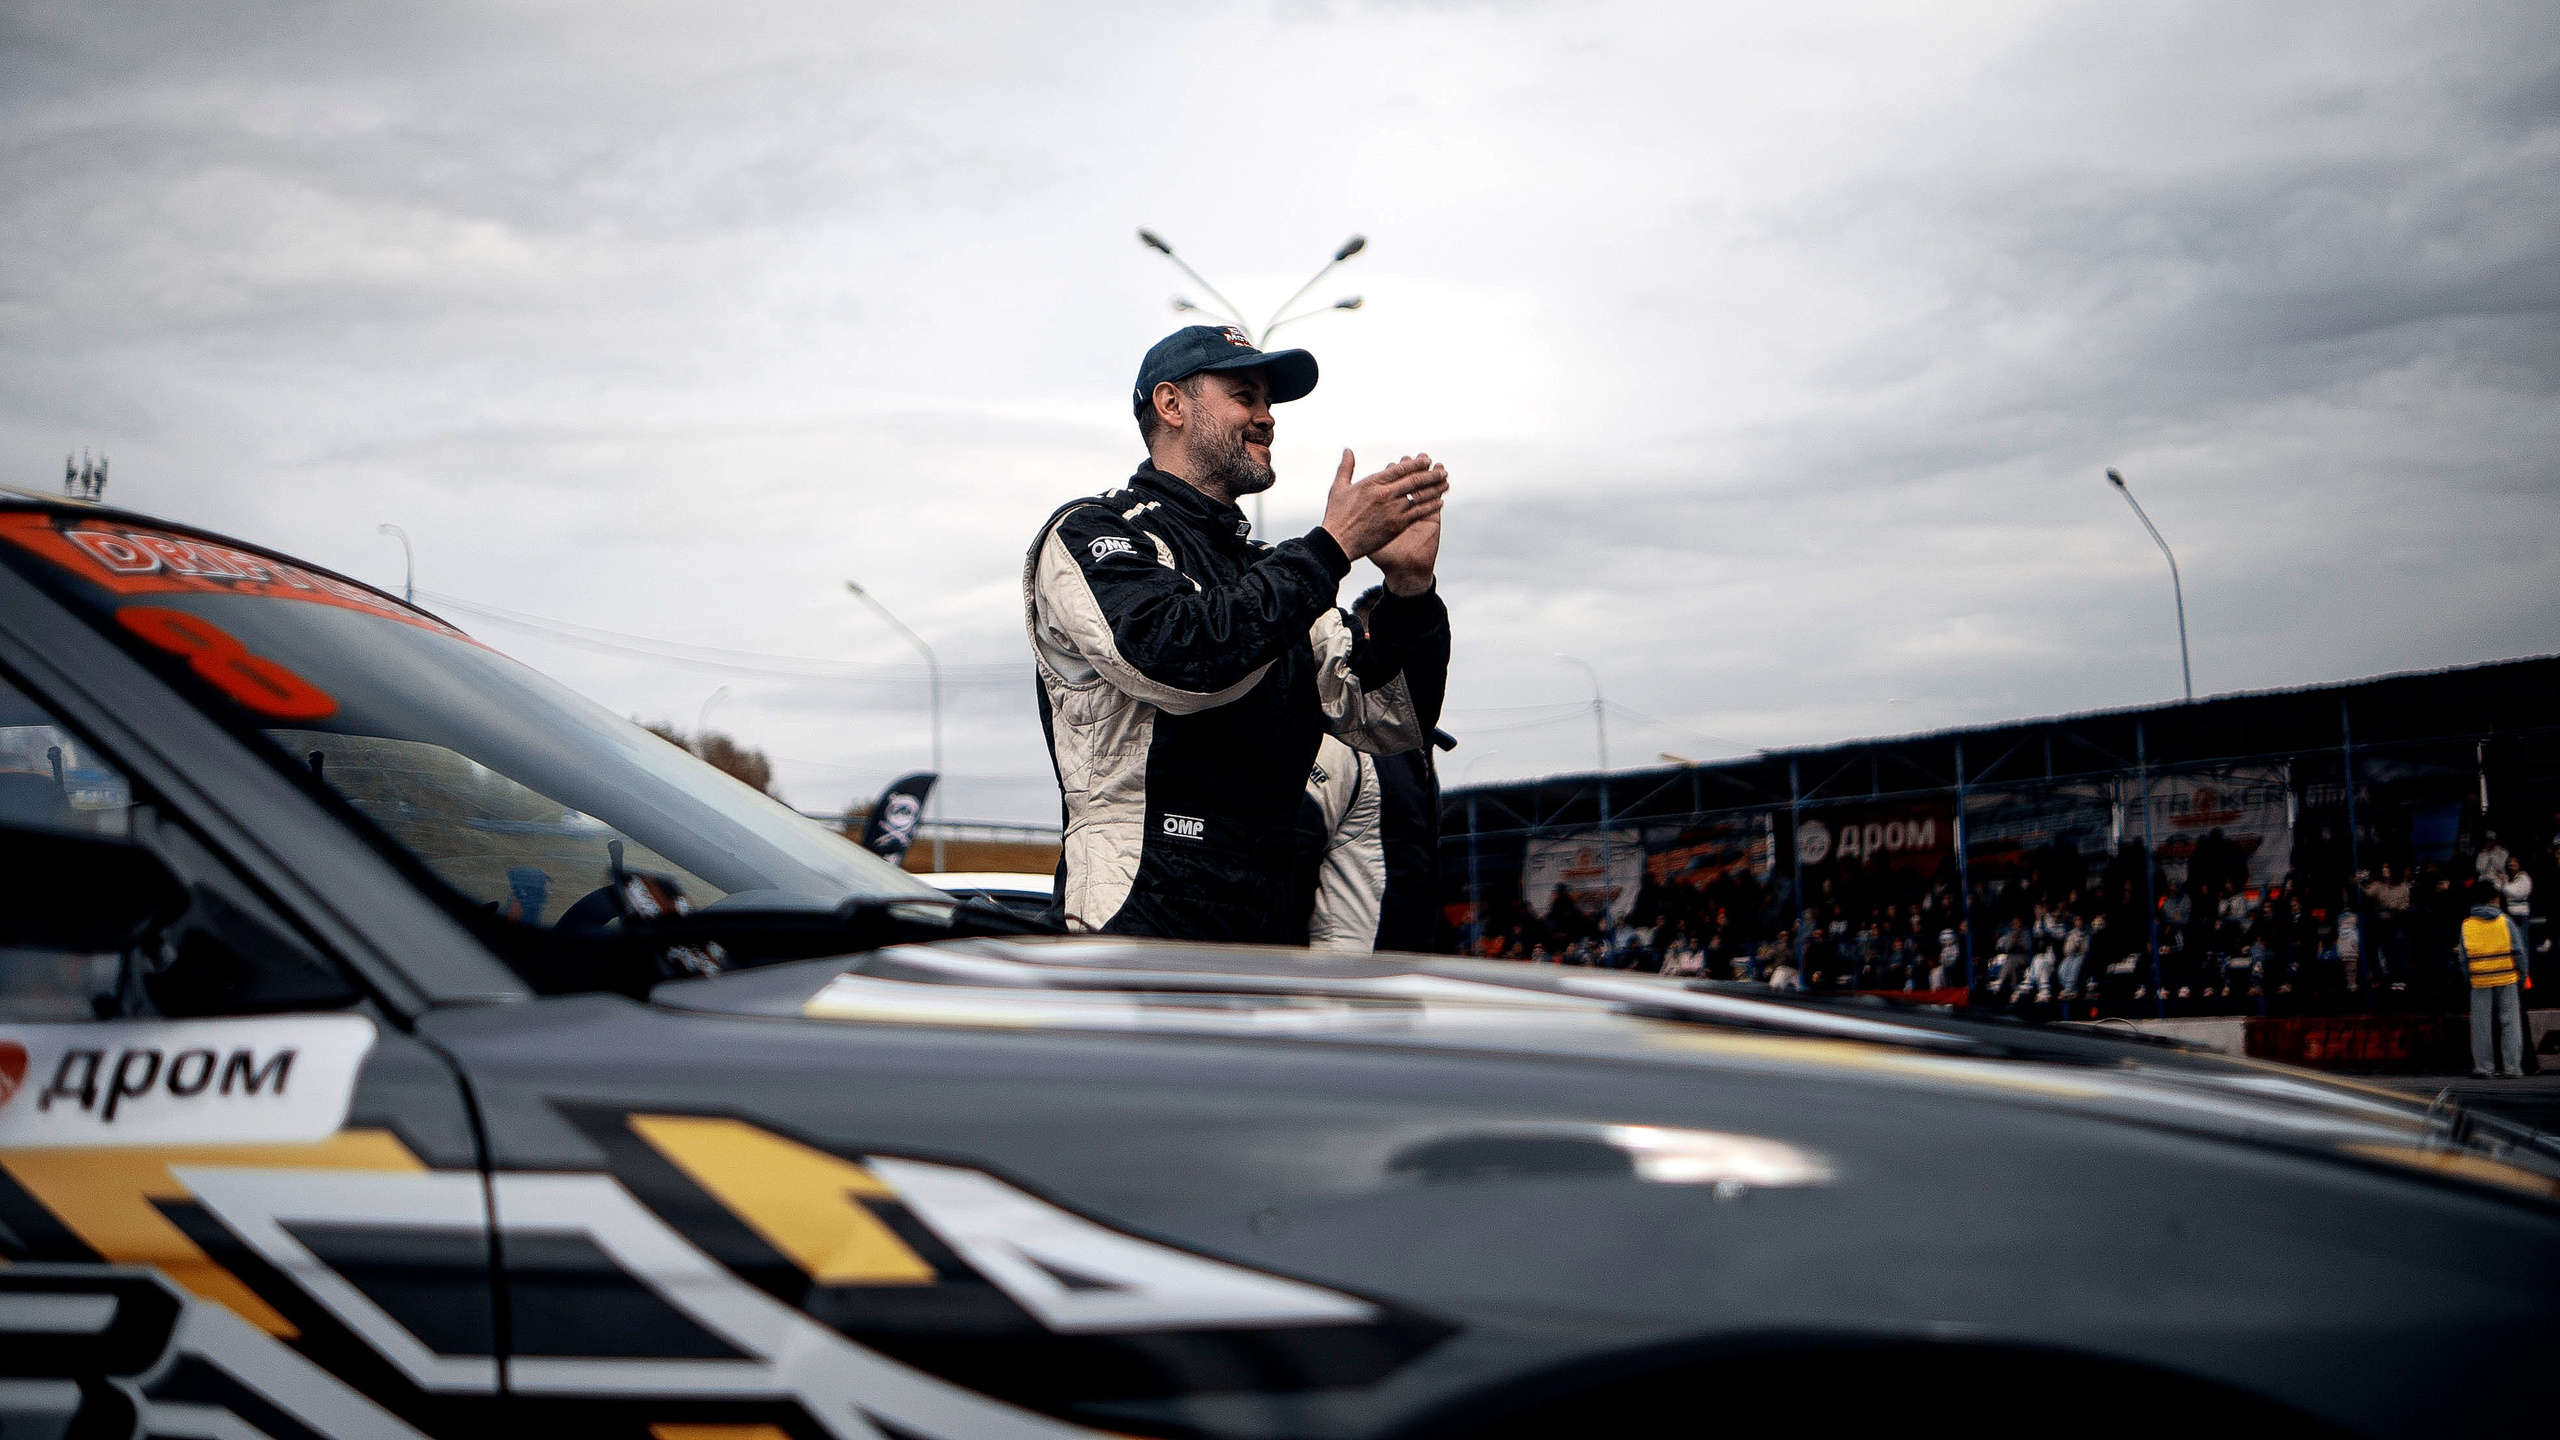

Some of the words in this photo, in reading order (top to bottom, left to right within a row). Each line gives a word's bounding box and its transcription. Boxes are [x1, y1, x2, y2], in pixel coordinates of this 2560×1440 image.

[1091, 539, 1133, 558] OMP
[114, 605, 339, 720] 8
[1310, 765, 1327, 783] MP
[1163, 817, 1204, 836] OMP
[1836, 818, 1936, 866] дром
[37, 1048, 297, 1123] дром
